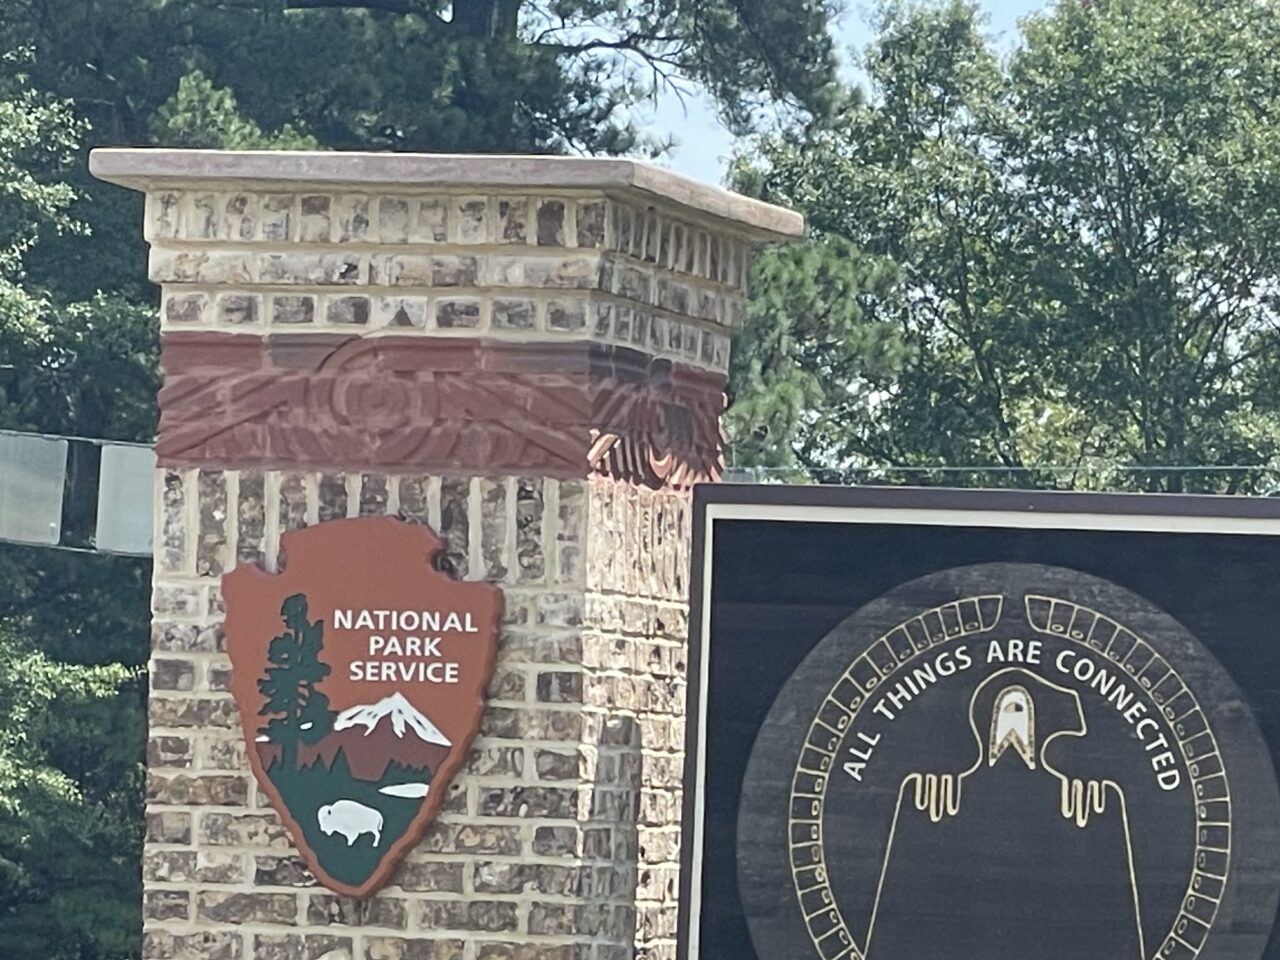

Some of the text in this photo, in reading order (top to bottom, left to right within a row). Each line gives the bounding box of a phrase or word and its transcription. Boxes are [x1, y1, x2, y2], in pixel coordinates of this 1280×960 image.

[333, 609, 479, 633] NATIONAL
[369, 635, 442, 657] PARK
[349, 660, 459, 683] SERVICE
[842, 639, 1181, 791] ALL THINGS ARE CONNECTED
